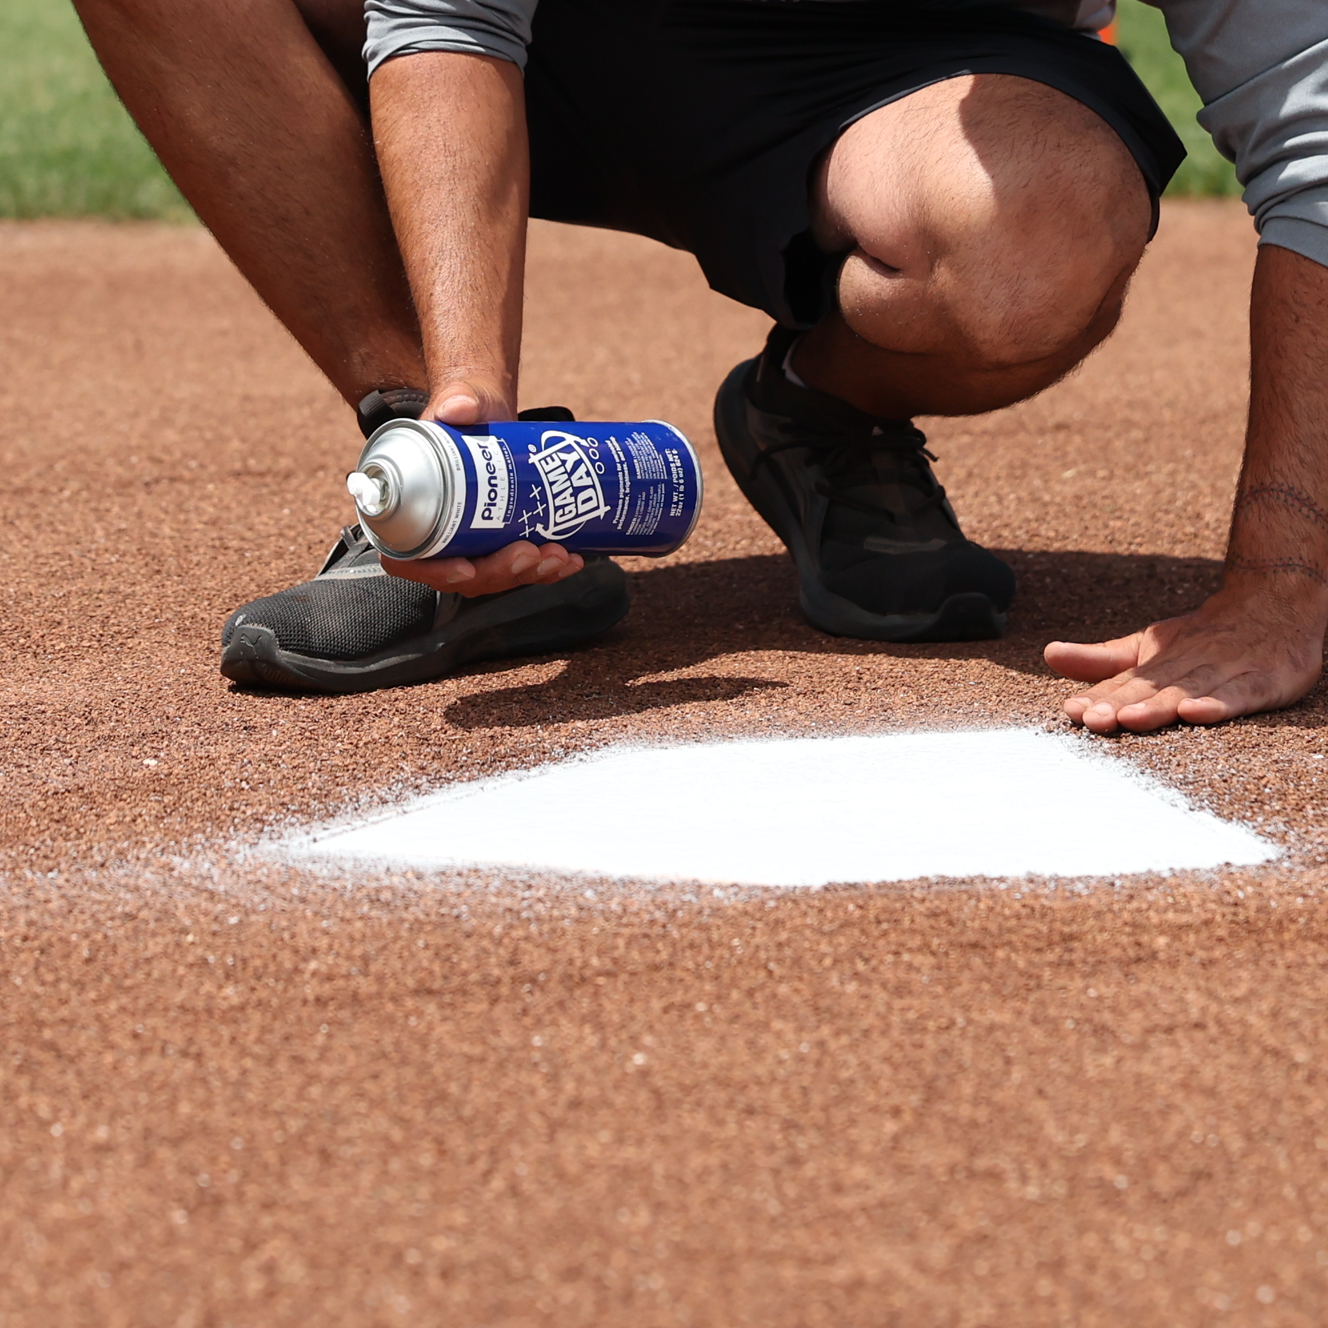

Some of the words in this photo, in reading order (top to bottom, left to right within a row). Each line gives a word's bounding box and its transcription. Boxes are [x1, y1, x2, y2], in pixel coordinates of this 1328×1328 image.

[476, 442, 498, 521] Pioneer
[539, 452, 578, 524] GAME
[556, 450, 599, 515] DAY
